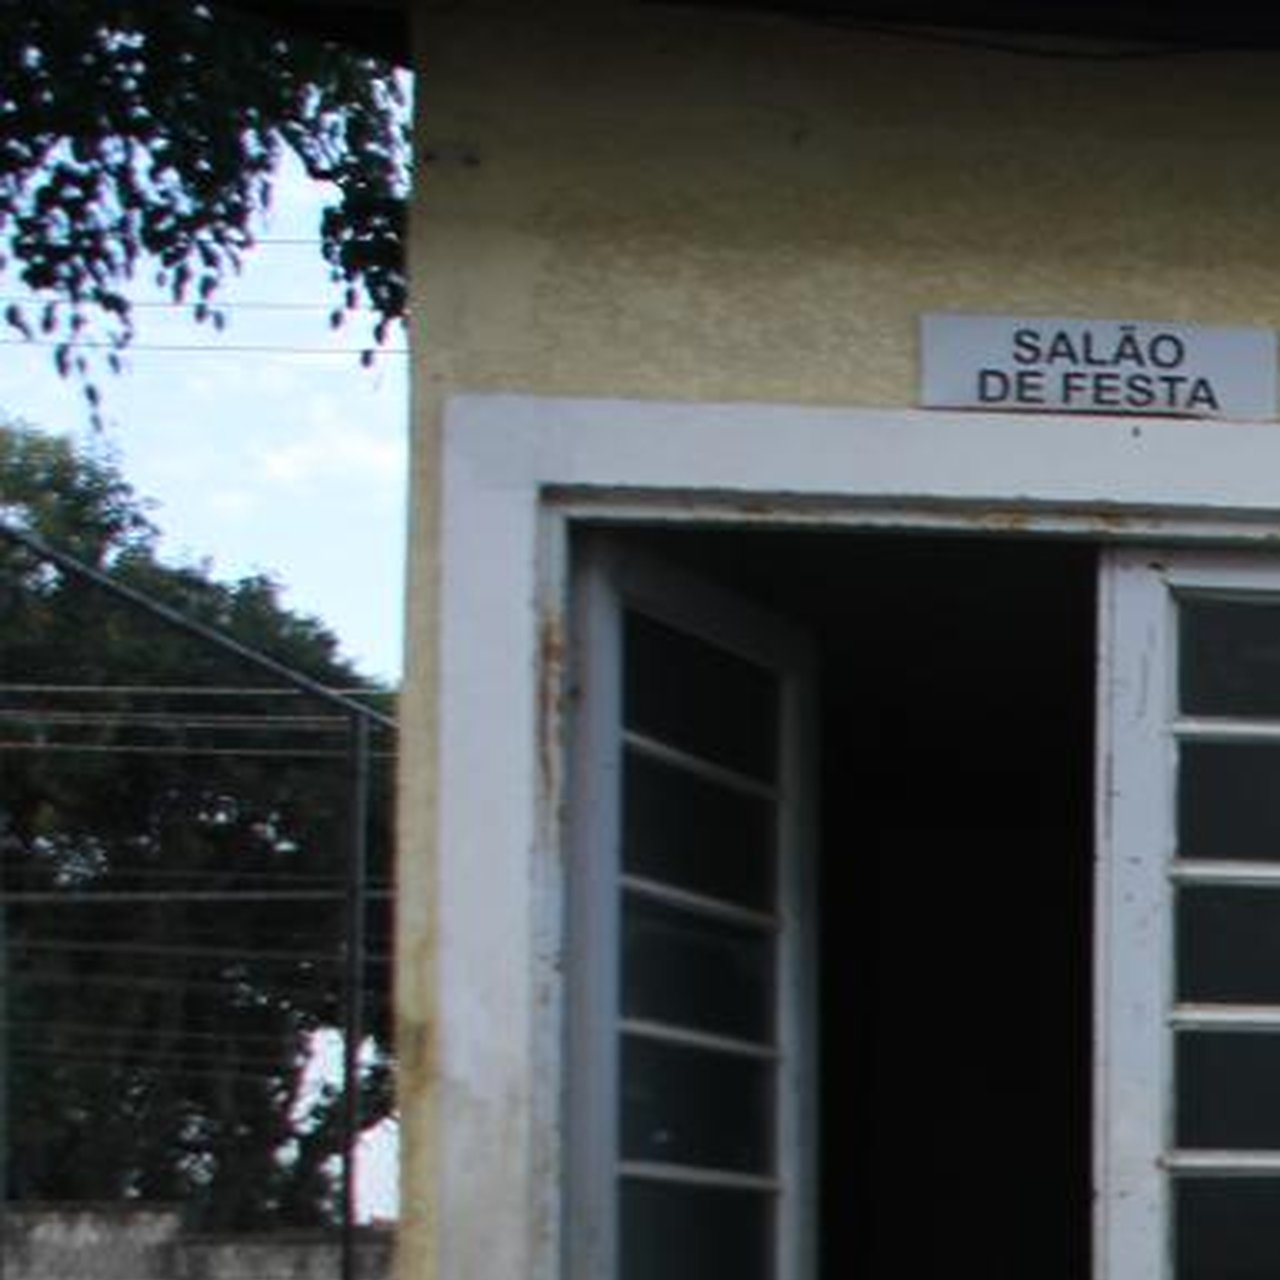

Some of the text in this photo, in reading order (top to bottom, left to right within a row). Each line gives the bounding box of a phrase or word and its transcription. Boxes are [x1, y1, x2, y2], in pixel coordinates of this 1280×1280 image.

[1012, 325, 1186, 369] SALÃO
[976, 368, 1221, 411] DE FESTA
